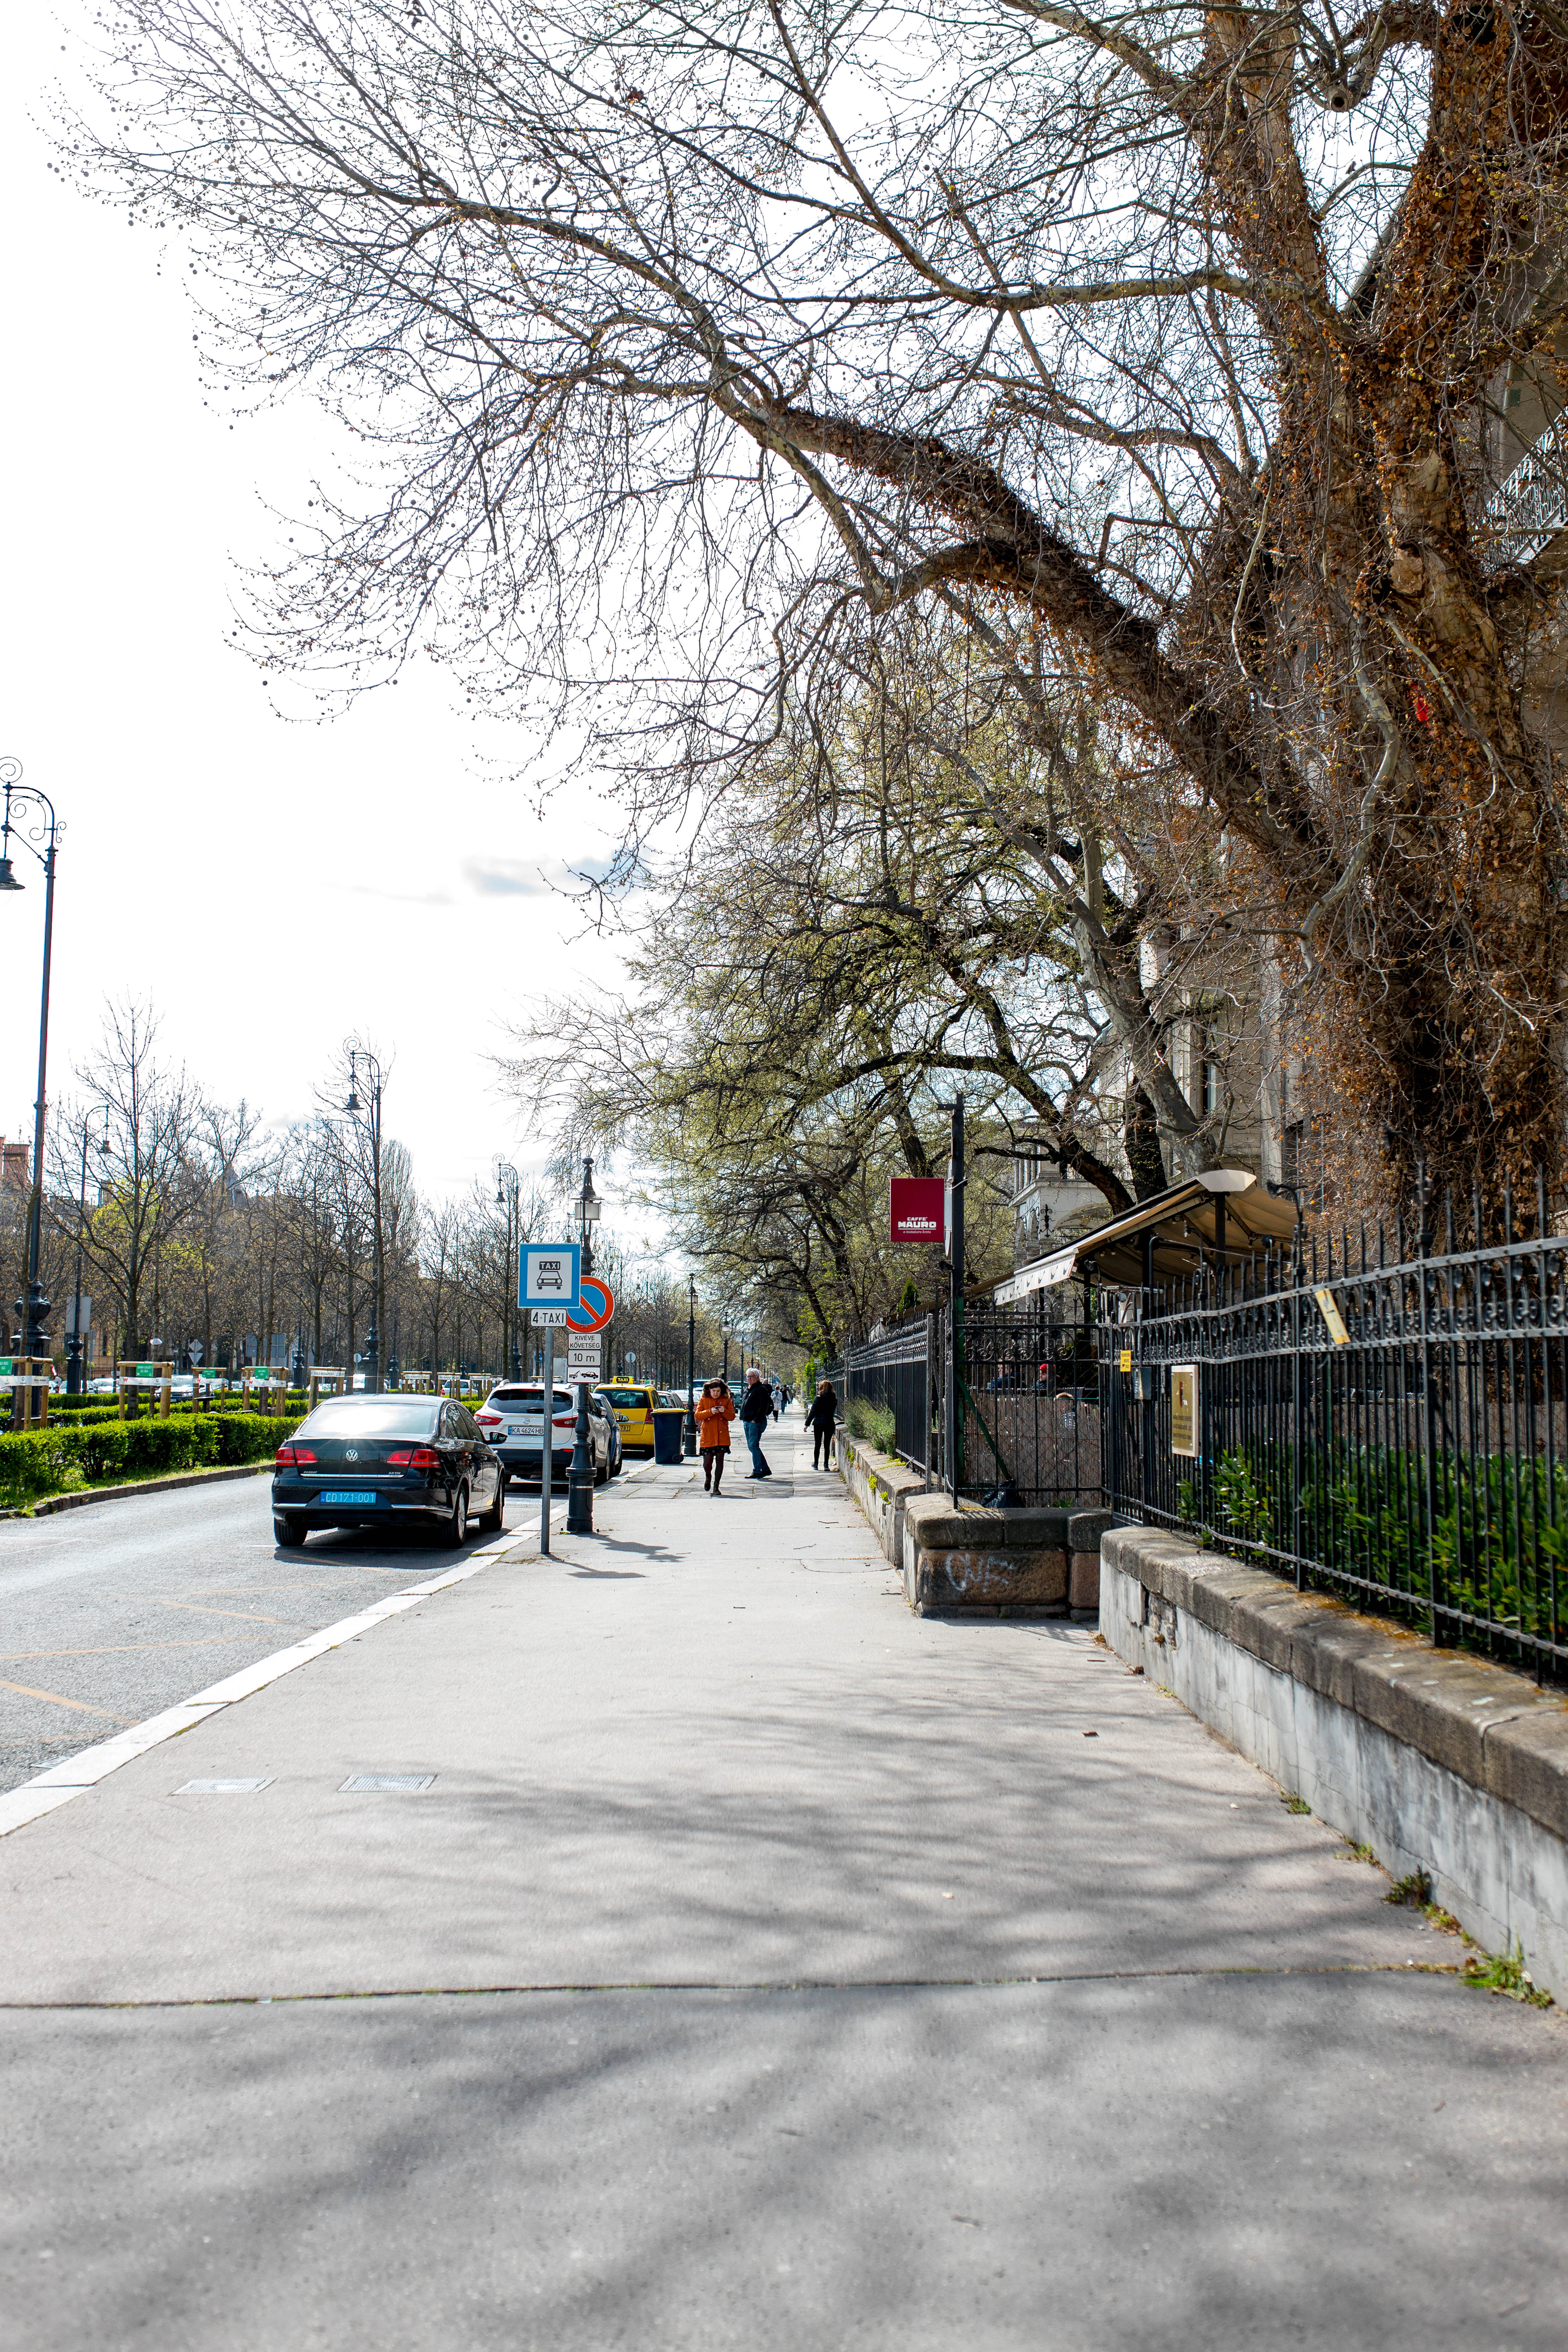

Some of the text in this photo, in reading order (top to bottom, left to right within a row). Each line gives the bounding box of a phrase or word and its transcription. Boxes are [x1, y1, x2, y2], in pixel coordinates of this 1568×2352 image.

[532, 1312, 564, 1323] 4 TAXI
[574, 1353, 582, 1361] 10
[326, 1493, 337, 1502] CD
[340, 1494, 374, 1502] 171-001
